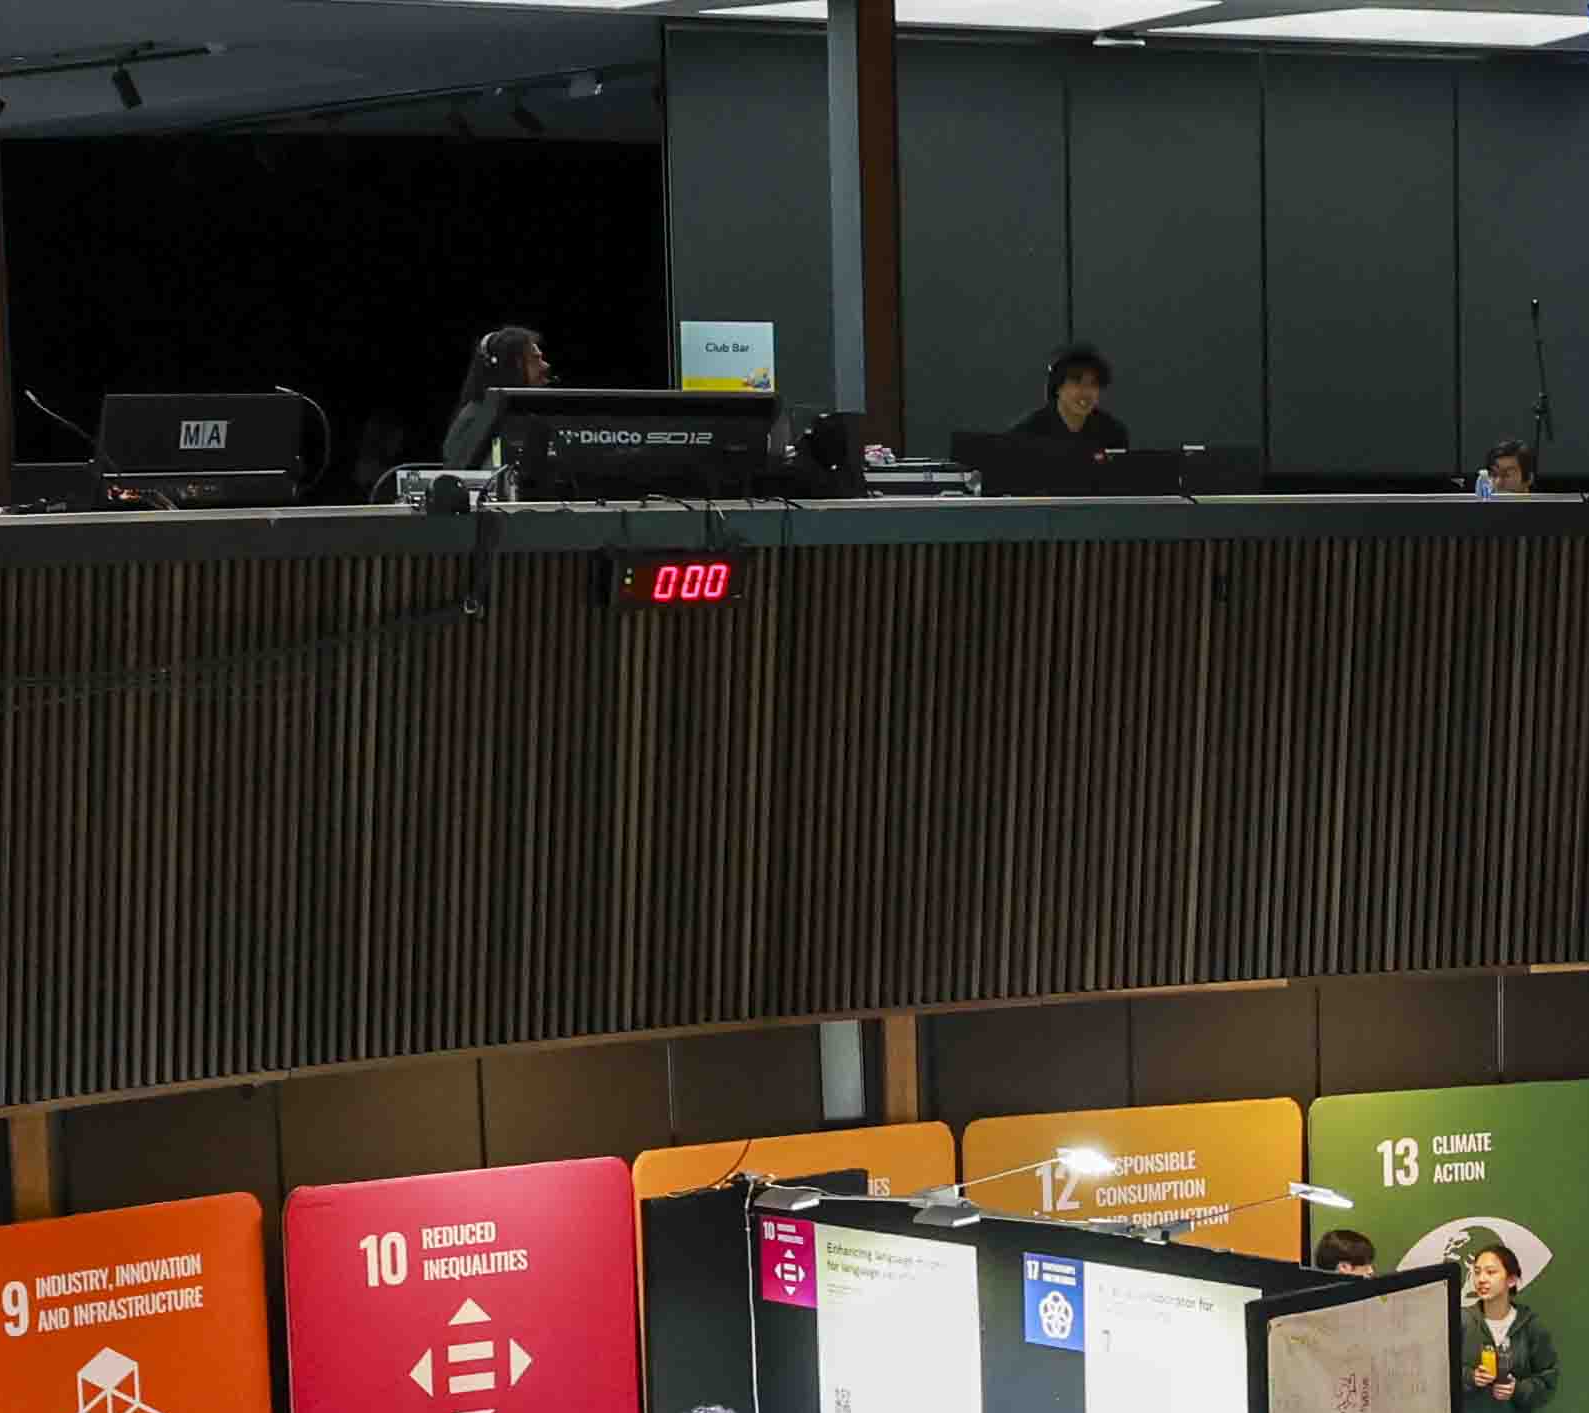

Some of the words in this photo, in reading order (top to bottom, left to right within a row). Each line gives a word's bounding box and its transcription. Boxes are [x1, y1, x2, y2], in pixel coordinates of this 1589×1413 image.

[705, 342, 728, 354] Club
[730, 342, 750, 353] Bar
[1433, 1132, 1492, 1155] CLIMATE
[1114, 1150, 1195, 1176] SPONSIBLE
[1377, 1137, 1419, 1186] 13
[1434, 1160, 1485, 1184] ACTION
[1036, 1166, 1080, 1212] 12
[1096, 1178, 1205, 1207] CONSUMPTION
[421, 1221, 496, 1250] REDUCED
[359, 1231, 408, 1287] 10
[423, 1249, 529, 1280] INEQUALITIES
[35, 1267, 114, 1300] INDUSTRY,
[115, 1253, 203, 1288] INNOVATION
[1, 1280, 30, 1337] 9
[38, 1306, 70, 1333] AND
[73, 1285, 204, 1327] INFRASTRUCTURE
